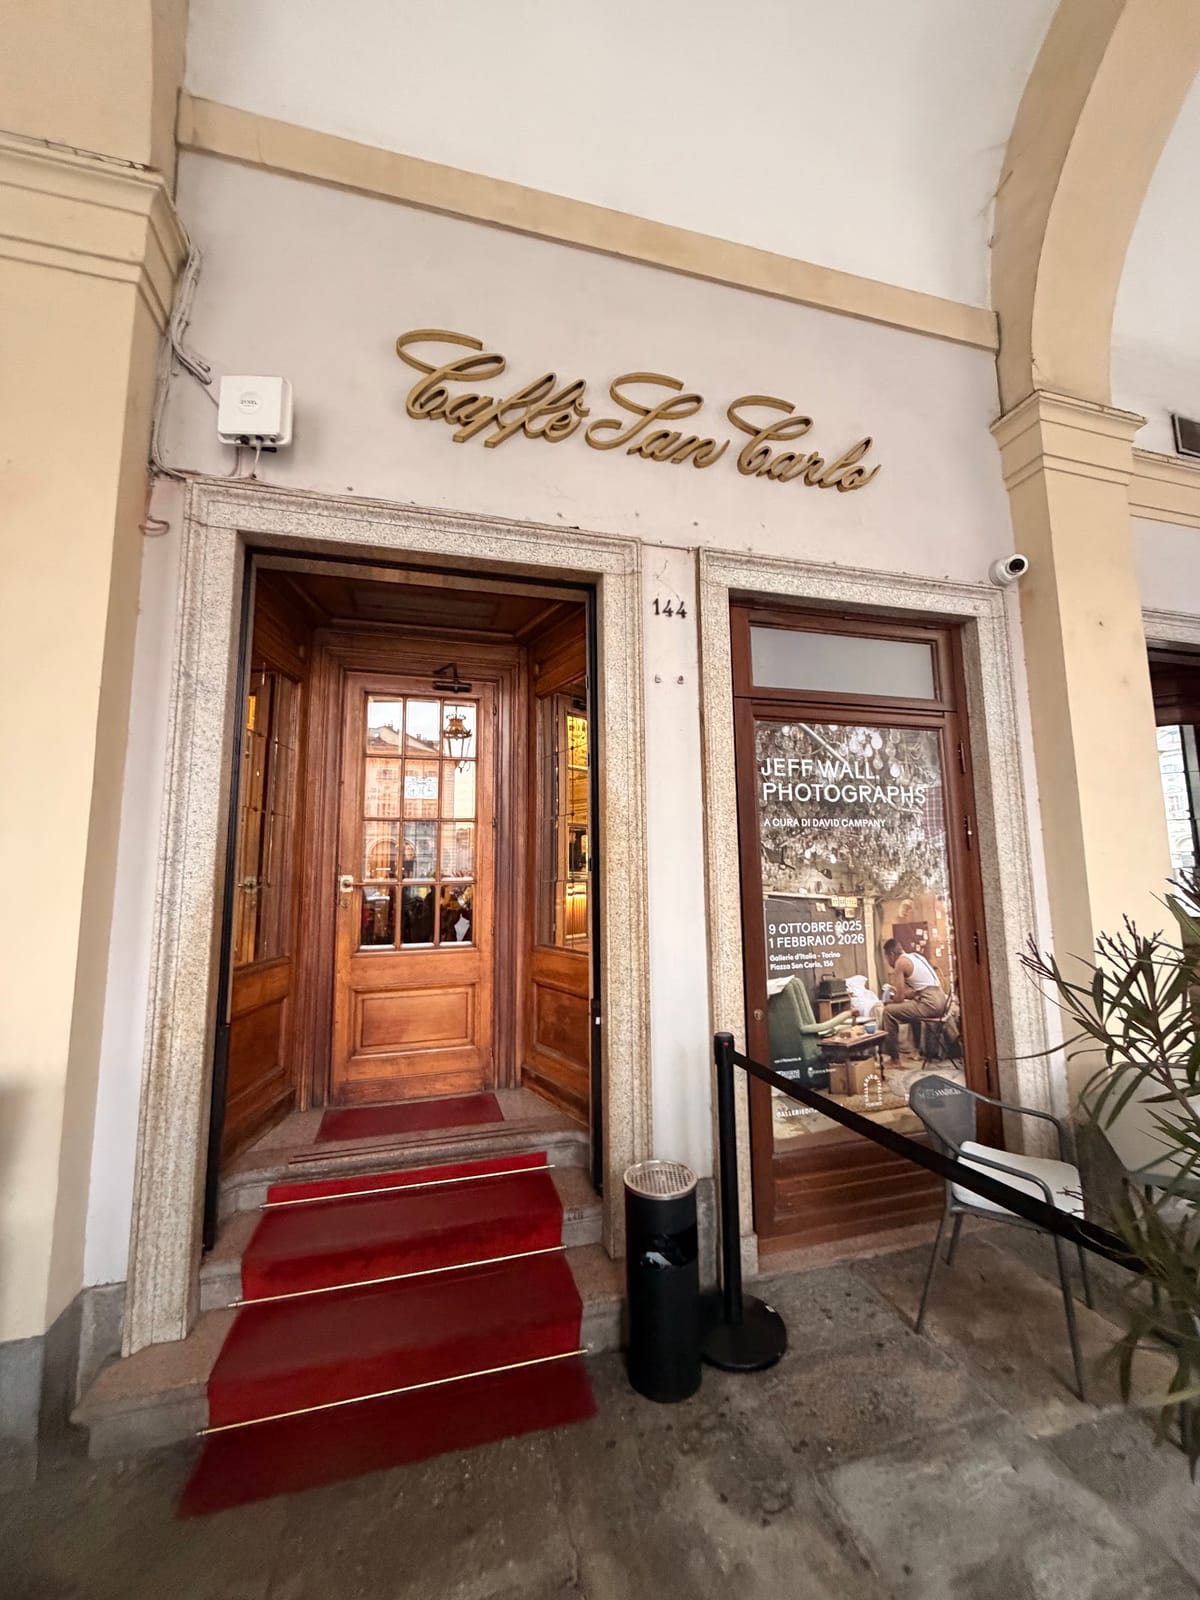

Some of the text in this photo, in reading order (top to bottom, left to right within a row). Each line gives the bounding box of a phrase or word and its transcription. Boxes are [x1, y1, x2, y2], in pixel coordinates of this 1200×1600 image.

[396, 328, 883, 493] Caffè San Carlo
[652, 597, 688, 619] 144
[760, 758, 880, 780] JEFF WALL.
[762, 782, 926, 805] PHOTOGRAPHS
[763, 818, 886, 828] A CURA DI DAVID CAMPANY
[768, 920, 863, 935] 9 OTTOBRE 2025
[768, 933, 865, 949] 1 FEBBRAIO 2026
[769, 953, 794, 962] Gallerie
[821, 951, 841, 959] Torino
[769, 962, 791, 971] Piazza
[791, 961, 804, 970] San
